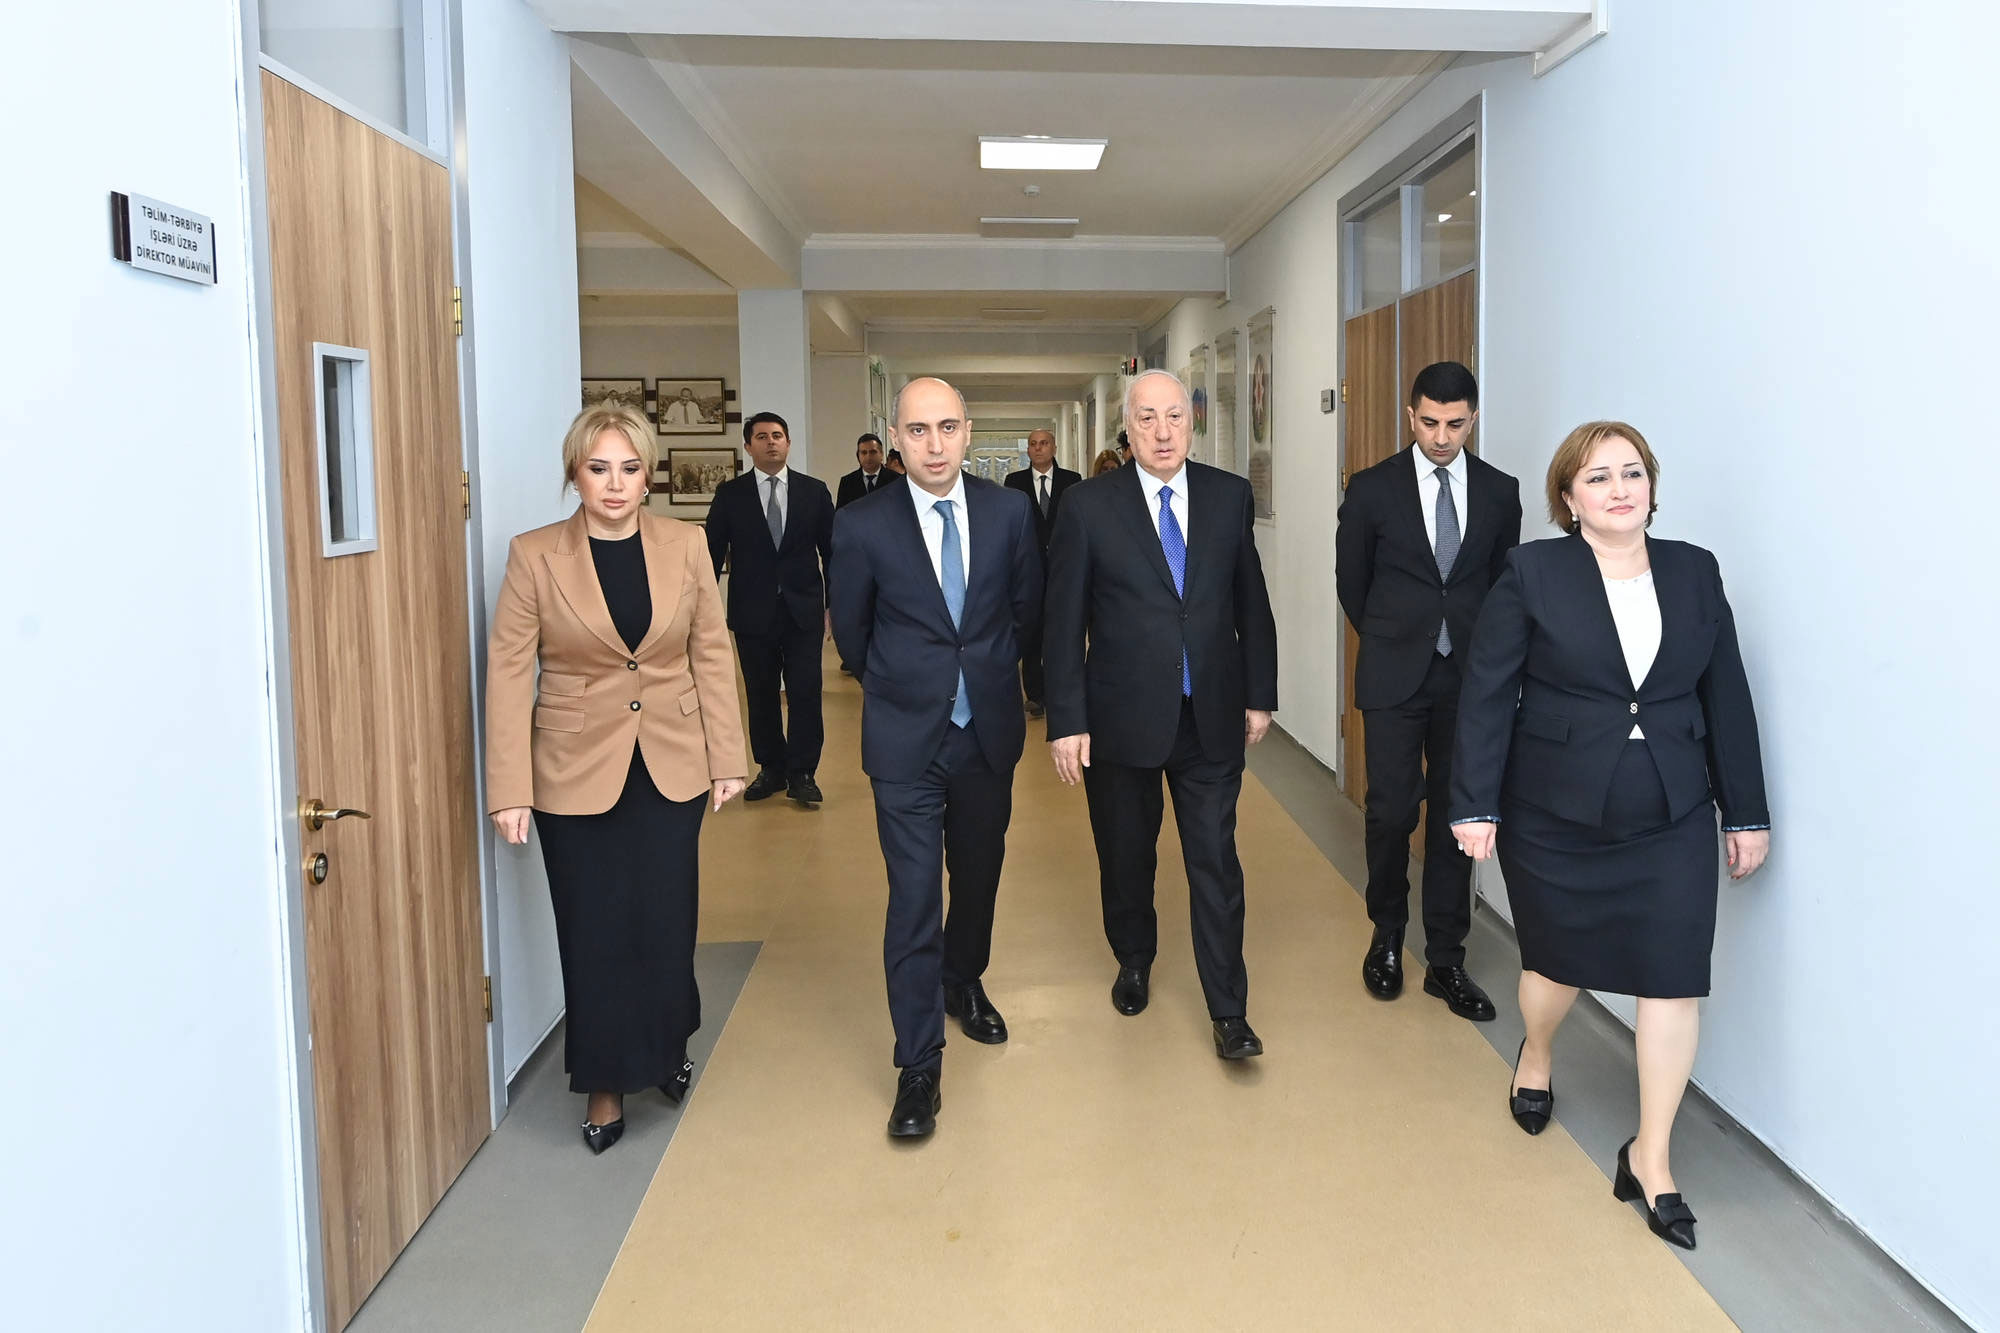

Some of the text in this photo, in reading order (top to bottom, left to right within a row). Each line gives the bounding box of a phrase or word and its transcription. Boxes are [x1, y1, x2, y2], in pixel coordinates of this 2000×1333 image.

[142, 206, 203, 234] TƏLİM-TƏRBİYƏ
[150, 226, 197, 252] İŞLƏRİ ÜZRƏ
[137, 244, 176, 266] DİREKTOR
